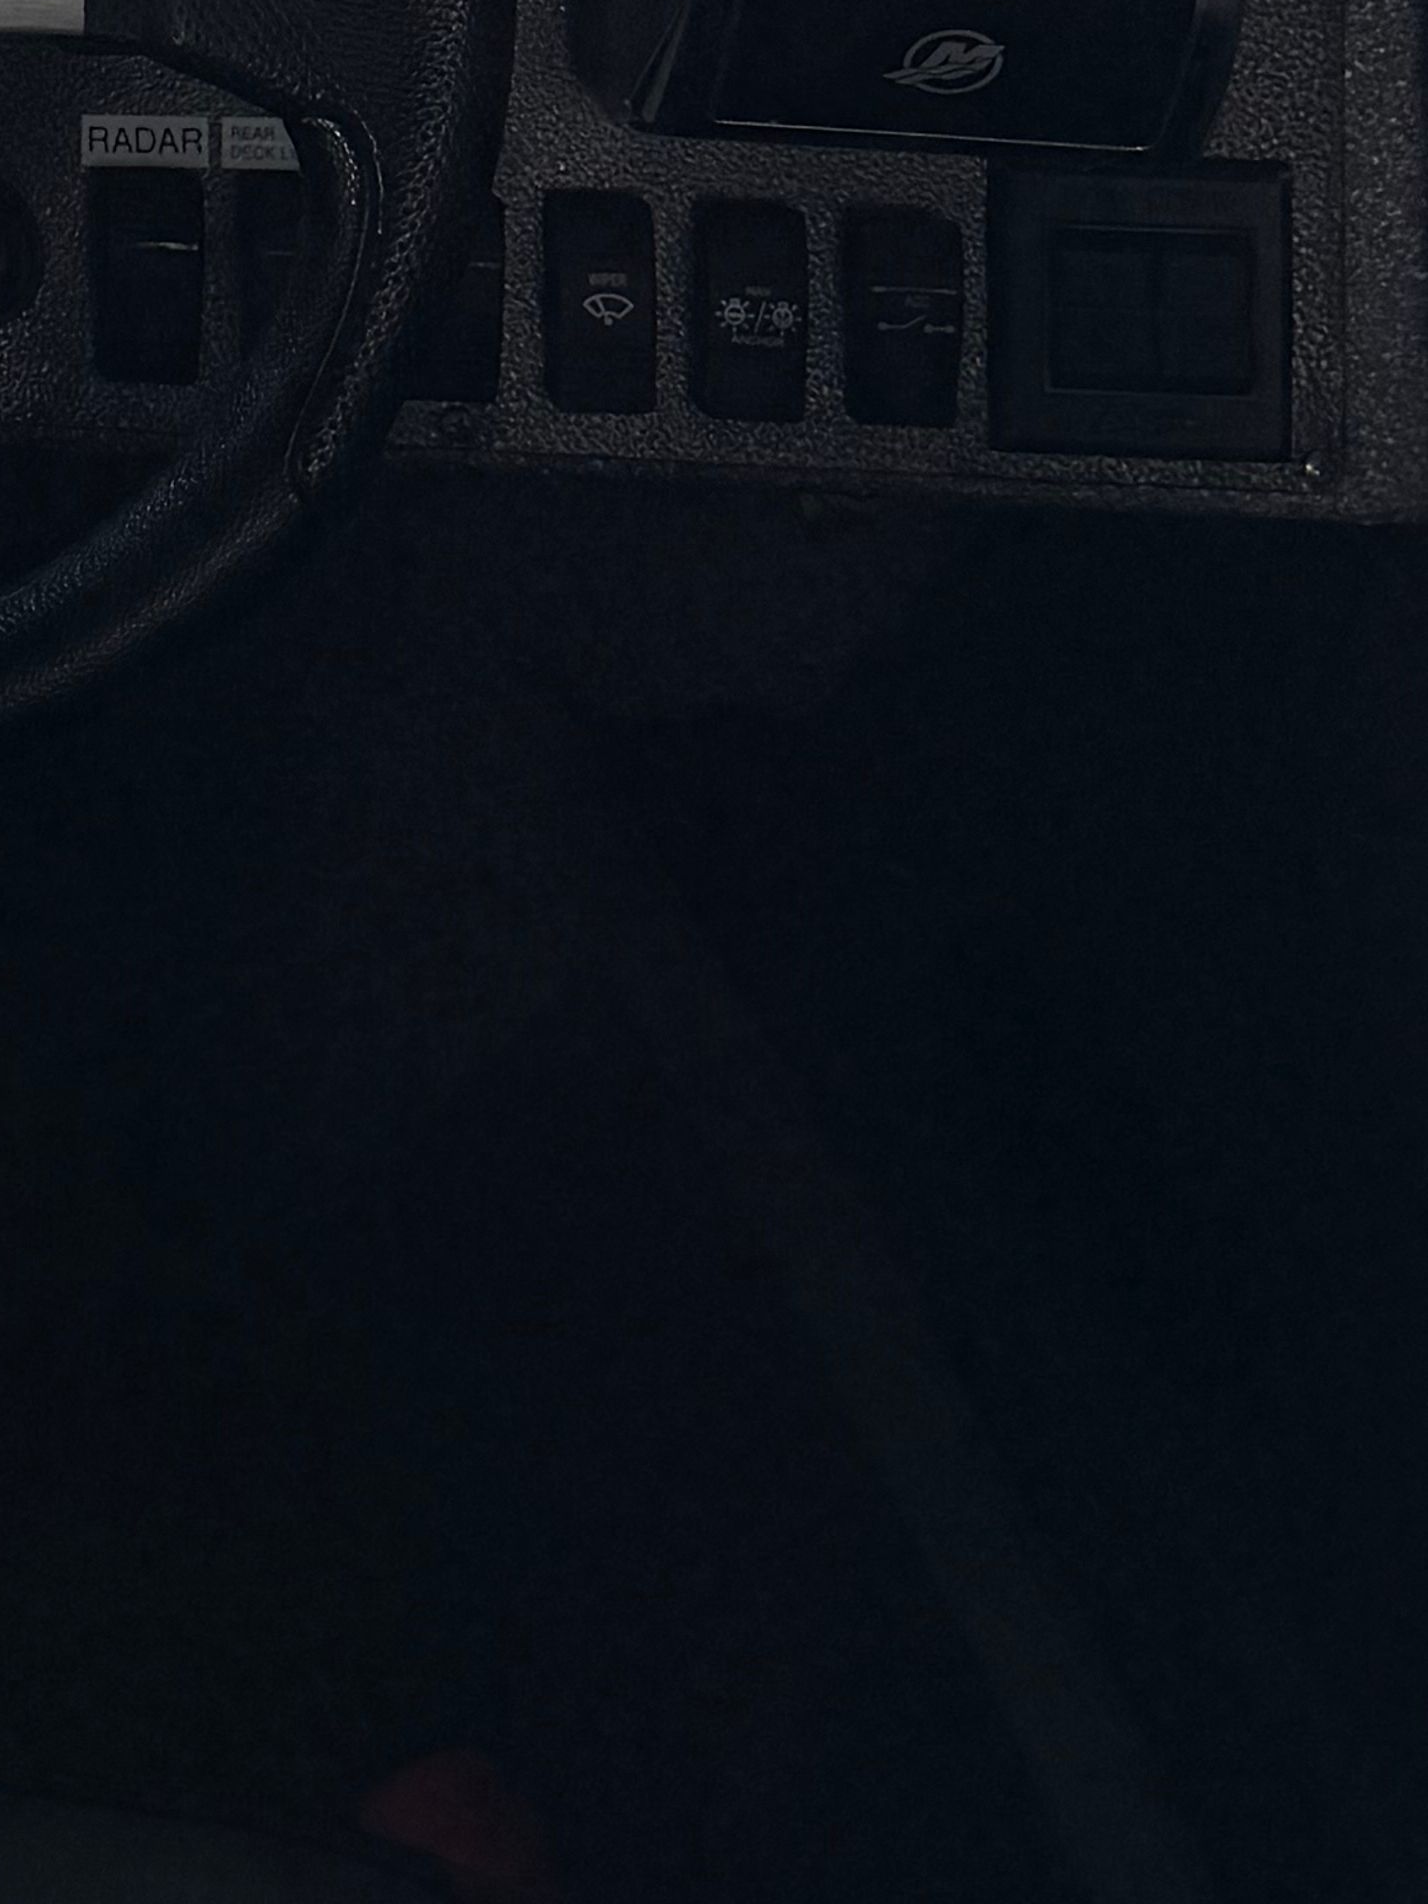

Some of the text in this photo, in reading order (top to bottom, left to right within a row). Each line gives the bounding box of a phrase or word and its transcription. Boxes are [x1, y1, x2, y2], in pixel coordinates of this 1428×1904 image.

[89, 126, 202, 153] RADAR
[230, 126, 275, 141] REAR
[230, 146, 270, 160] DECK
